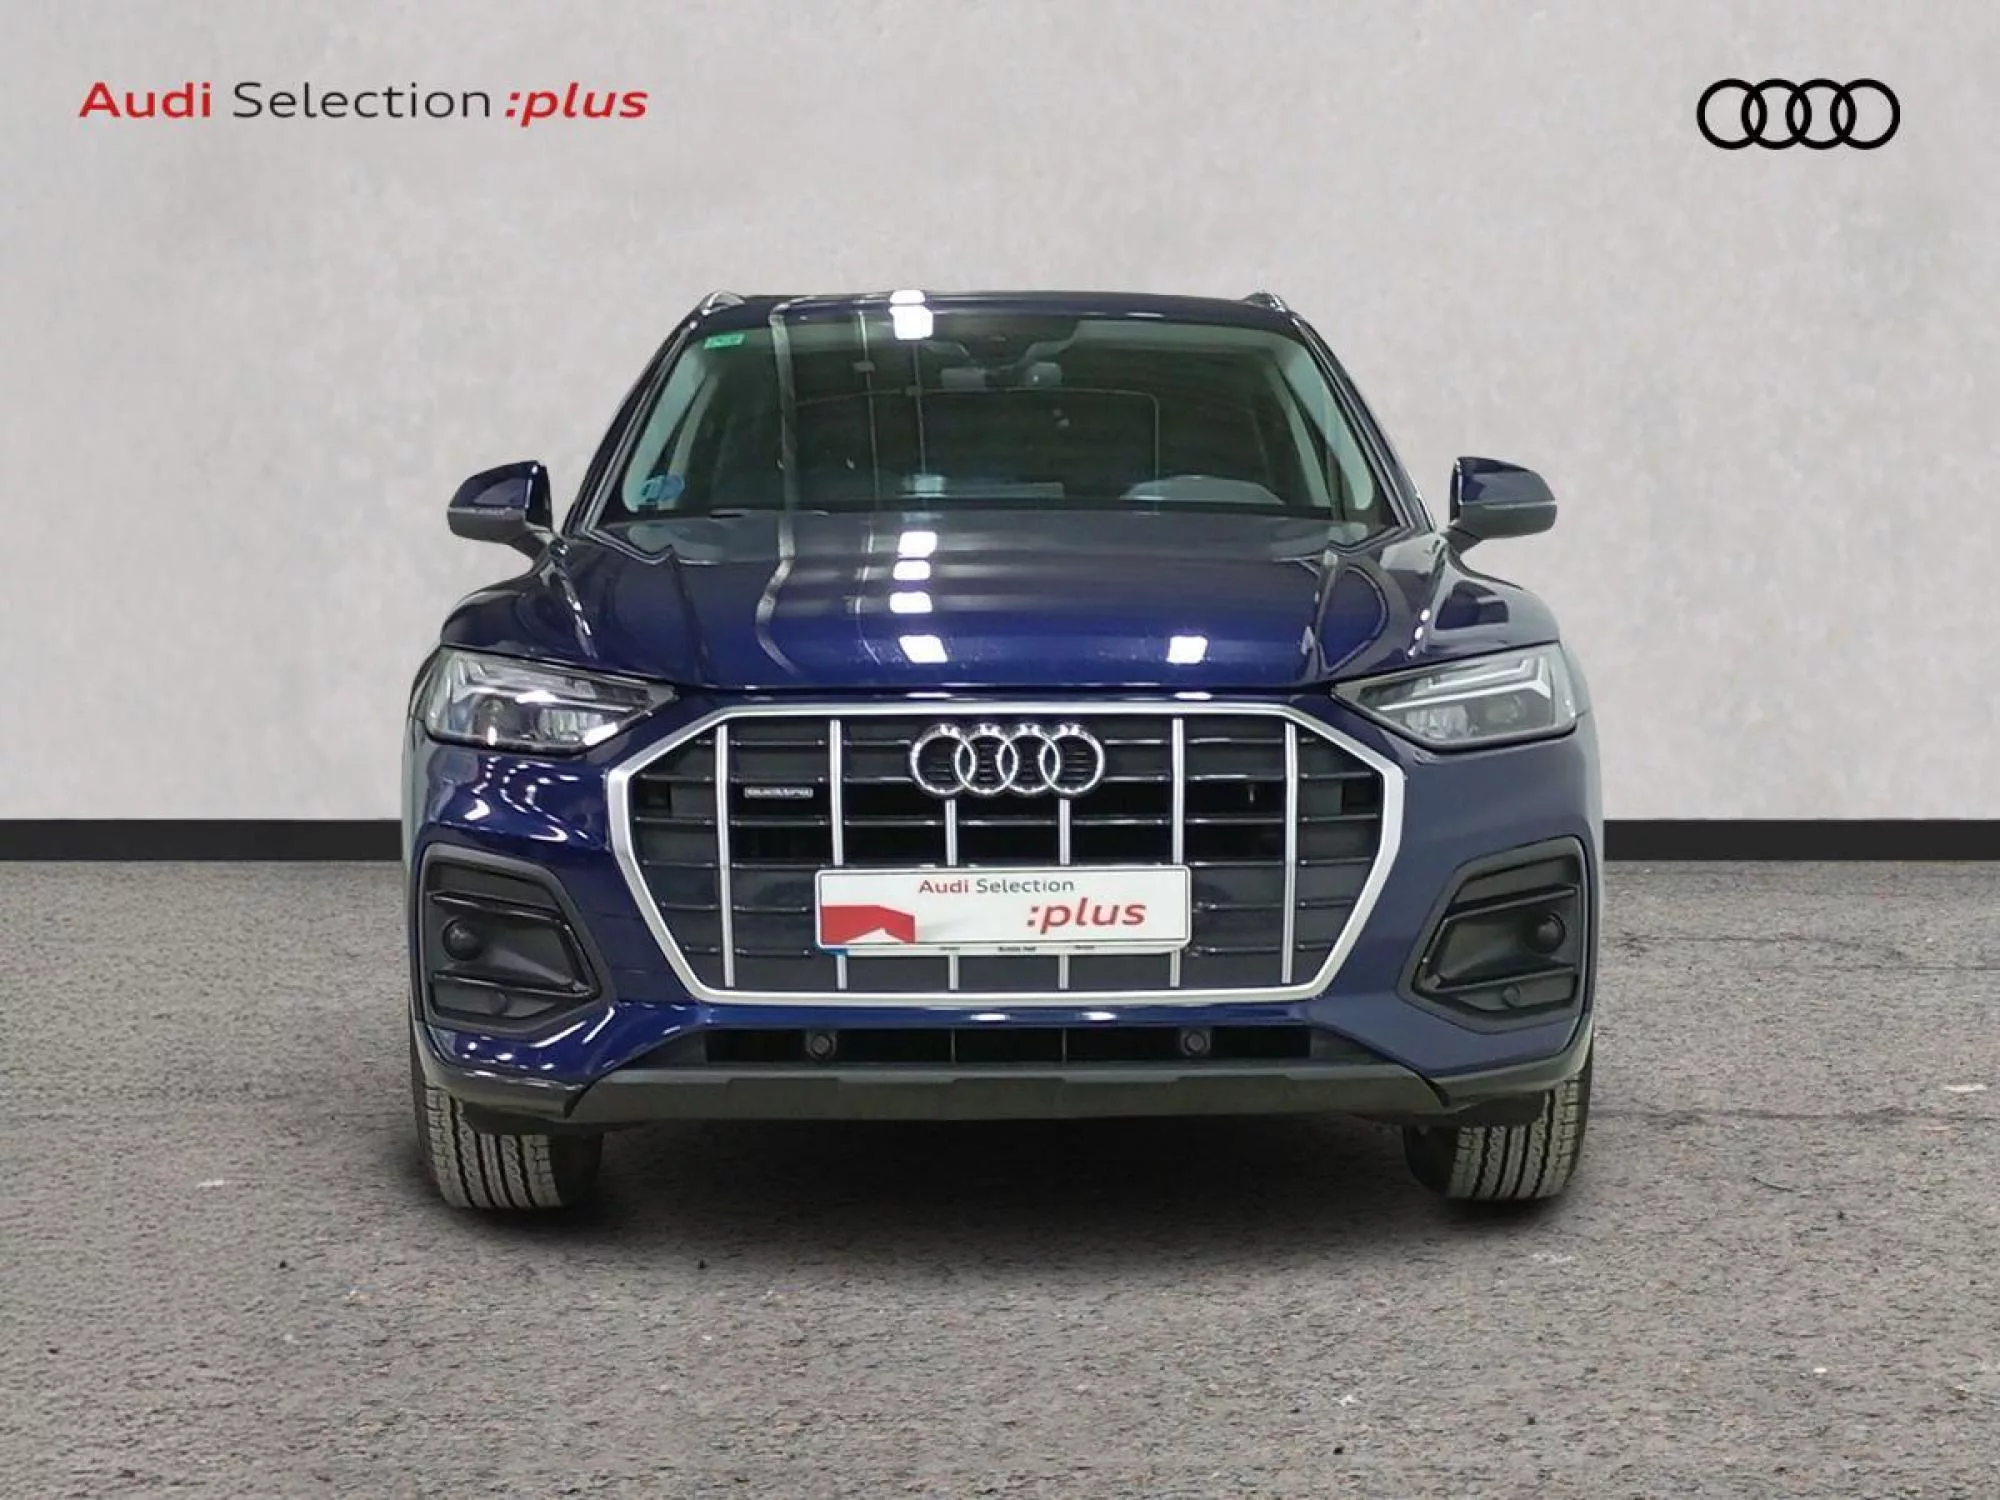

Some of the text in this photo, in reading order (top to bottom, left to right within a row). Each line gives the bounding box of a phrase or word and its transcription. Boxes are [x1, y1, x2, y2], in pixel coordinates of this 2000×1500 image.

[918, 878, 1075, 894] Audi Selection
[1026, 897, 1147, 935] :plus
